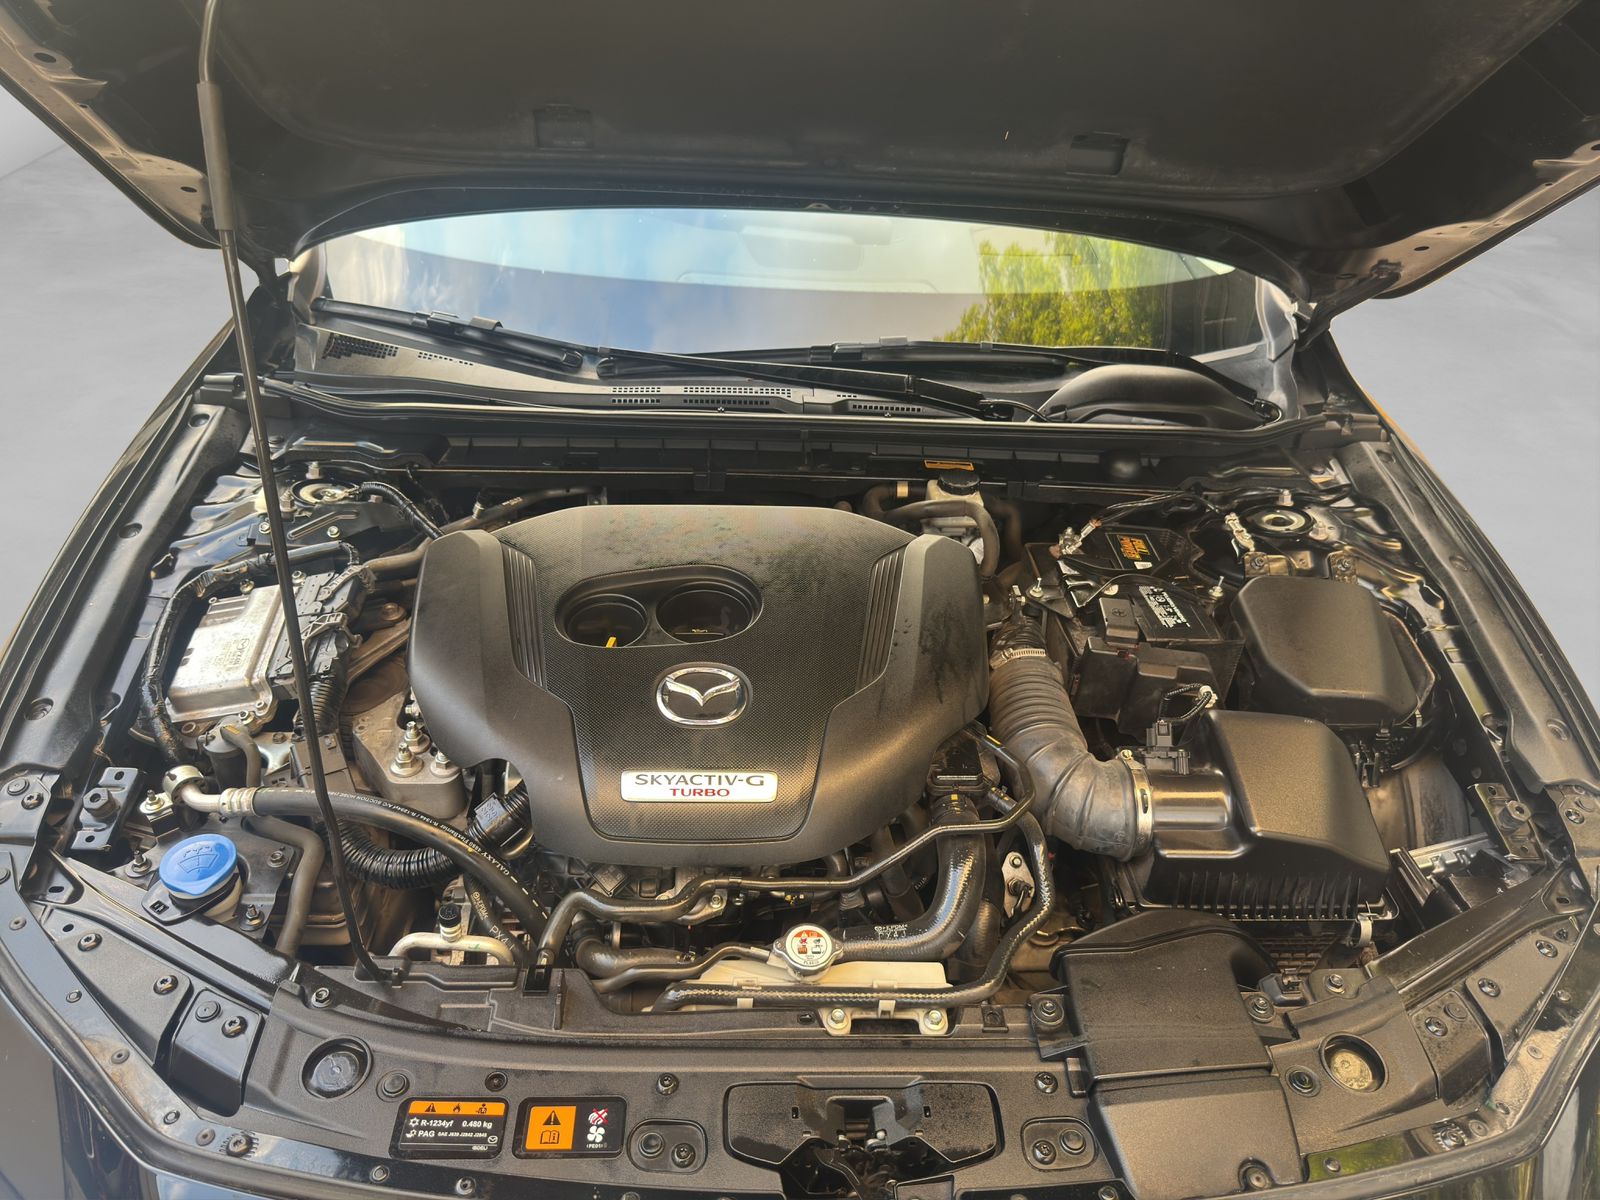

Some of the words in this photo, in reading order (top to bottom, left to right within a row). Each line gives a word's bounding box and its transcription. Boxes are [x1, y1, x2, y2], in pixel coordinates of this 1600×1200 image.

[635, 774, 764, 786] SKYACTIV-G
[670, 788, 730, 797] TURBO
[481, 852, 510, 876] GALAXY
[420, 1119, 454, 1128] R-1234yf
[482, 1120, 493, 1129] kg
